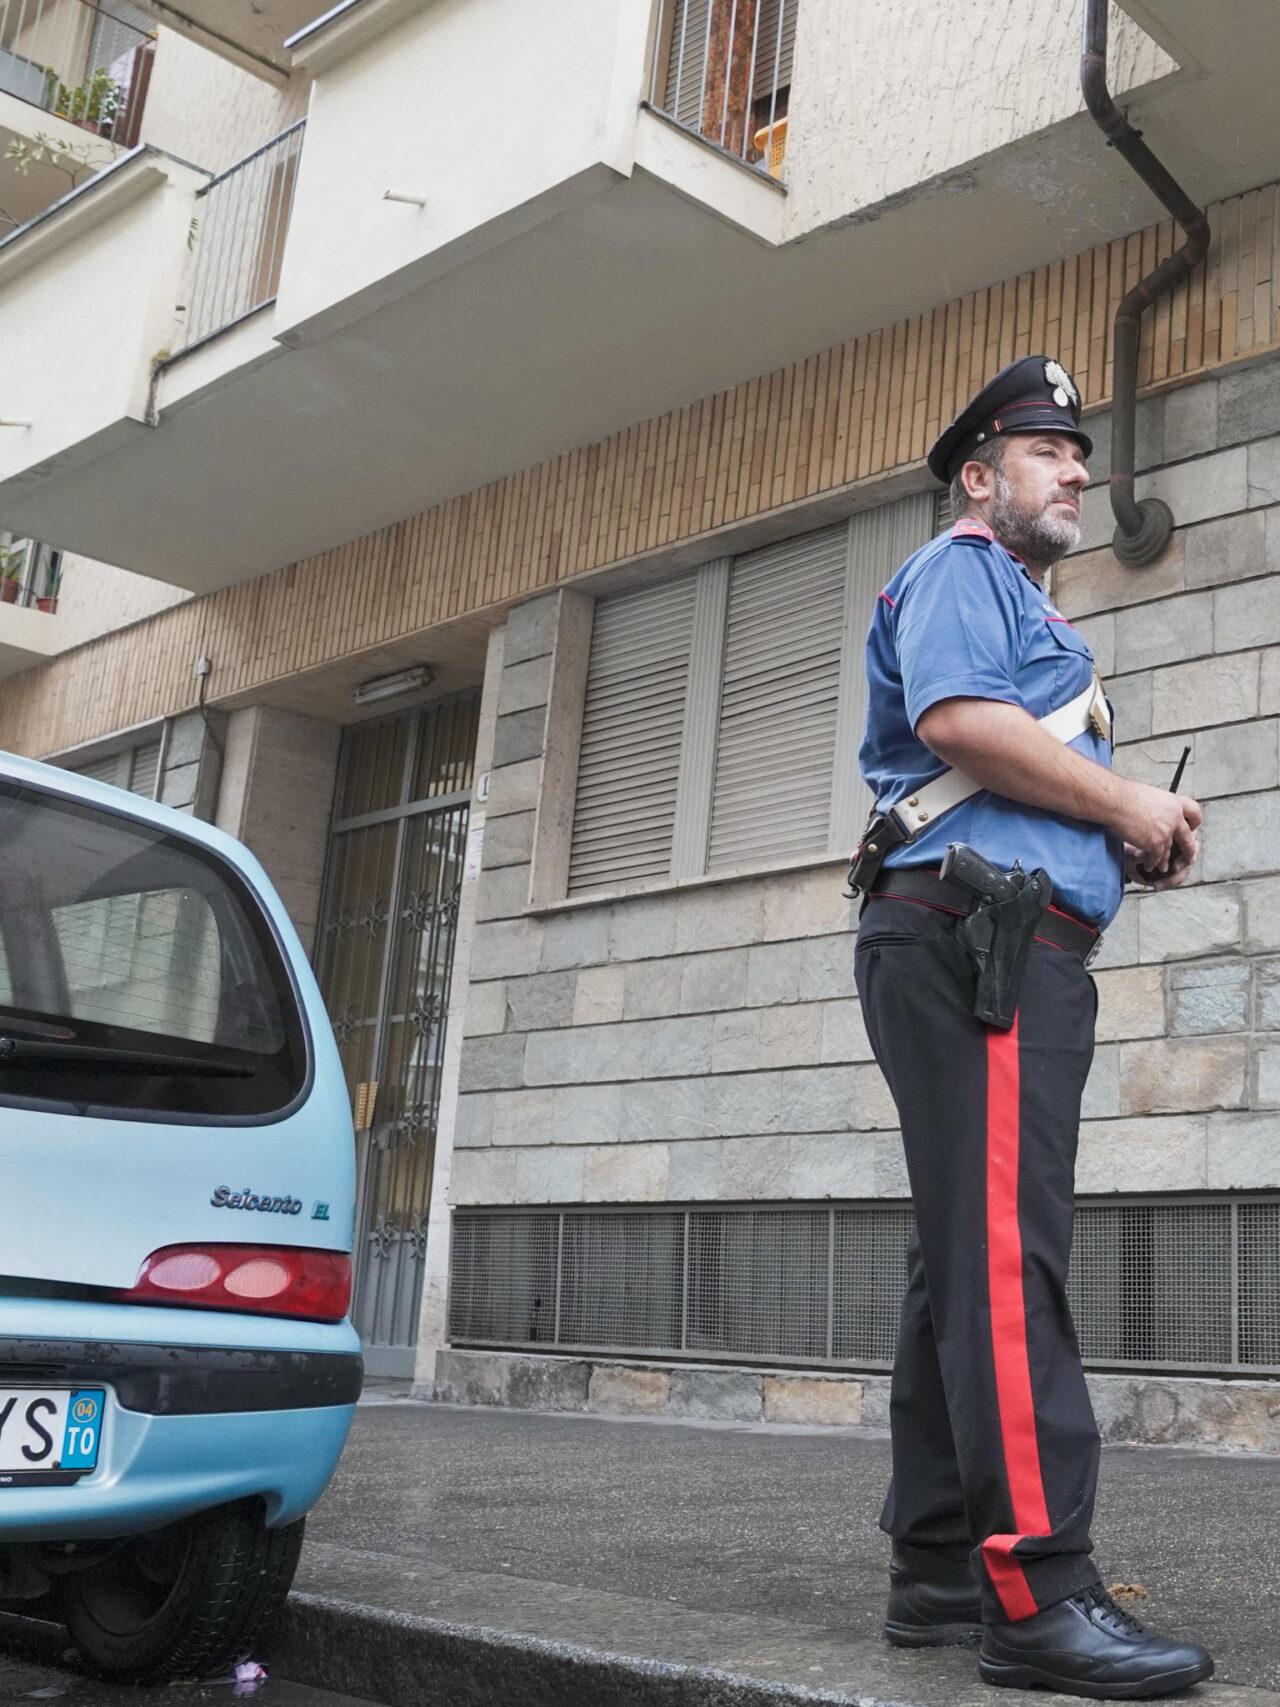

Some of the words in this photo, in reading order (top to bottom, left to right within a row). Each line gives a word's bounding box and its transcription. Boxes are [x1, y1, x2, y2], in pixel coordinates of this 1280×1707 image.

[210, 1185, 302, 1215] Seicento
[77, 1402, 92, 1418] 04
[68, 1426, 94, 1456] TO
